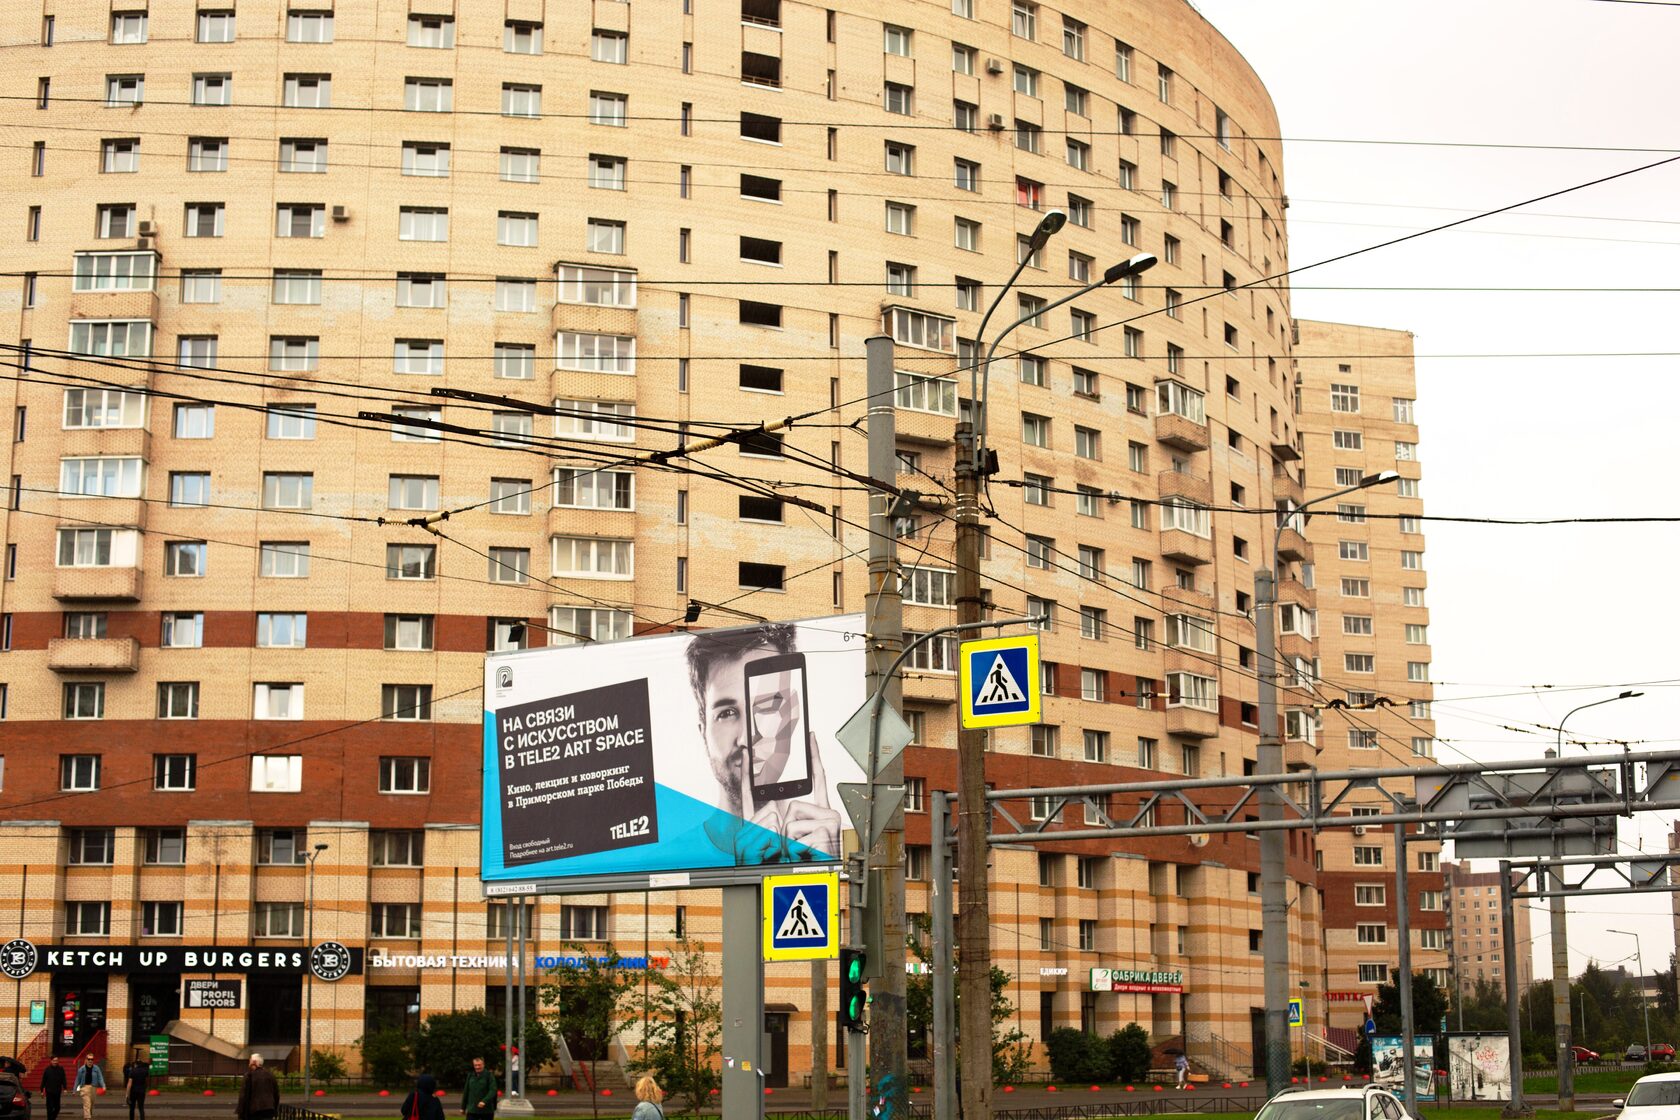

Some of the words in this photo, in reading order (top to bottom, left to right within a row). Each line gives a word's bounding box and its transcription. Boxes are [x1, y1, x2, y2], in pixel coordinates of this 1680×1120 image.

[502, 716, 523, 733] НА
[525, 704, 575, 728] СВЯЗИ
[503, 736, 515, 751] С
[517, 714, 619, 749] ИСКУССТВОМ
[505, 754, 515, 770] В
[517, 745, 561, 767] TELE2
[563, 738, 593, 758] ART
[595, 728, 645, 752] SPACE
[507, 784, 533, 796] Кино,
[535, 778, 569, 790] лекции
[571, 775, 578, 783] и
[579, 764, 630, 782] коворкинг
[507, 800, 514, 809] в
[515, 790, 575, 809] Приморском
[577, 783, 605, 796] парке
[606, 775, 644, 790] Победы
[609, 815, 650, 840] TELE2
[509, 842, 522, 851] Вход
[522, 837, 551, 848] свободный
[509, 849, 538, 859] Подробнее
[545, 842, 574, 854] art.tele2.ru
[47, 951, 123, 967] KETCH
[139, 951, 168, 967] UP
[184, 952, 302, 967] BURGERS
[372, 955, 447, 968] БЫТОВАЯ
[450, 955, 519, 968] ТЕХНИКА
[190, 981, 219, 989] ДВЕРИ
[1112, 970, 1151, 983] ФАБРИКА
[1151, 970, 1184, 984] ДВЕРЕЙ
[202, 990, 236, 999] PROFIL
[202, 998, 236, 1007] DOORS
